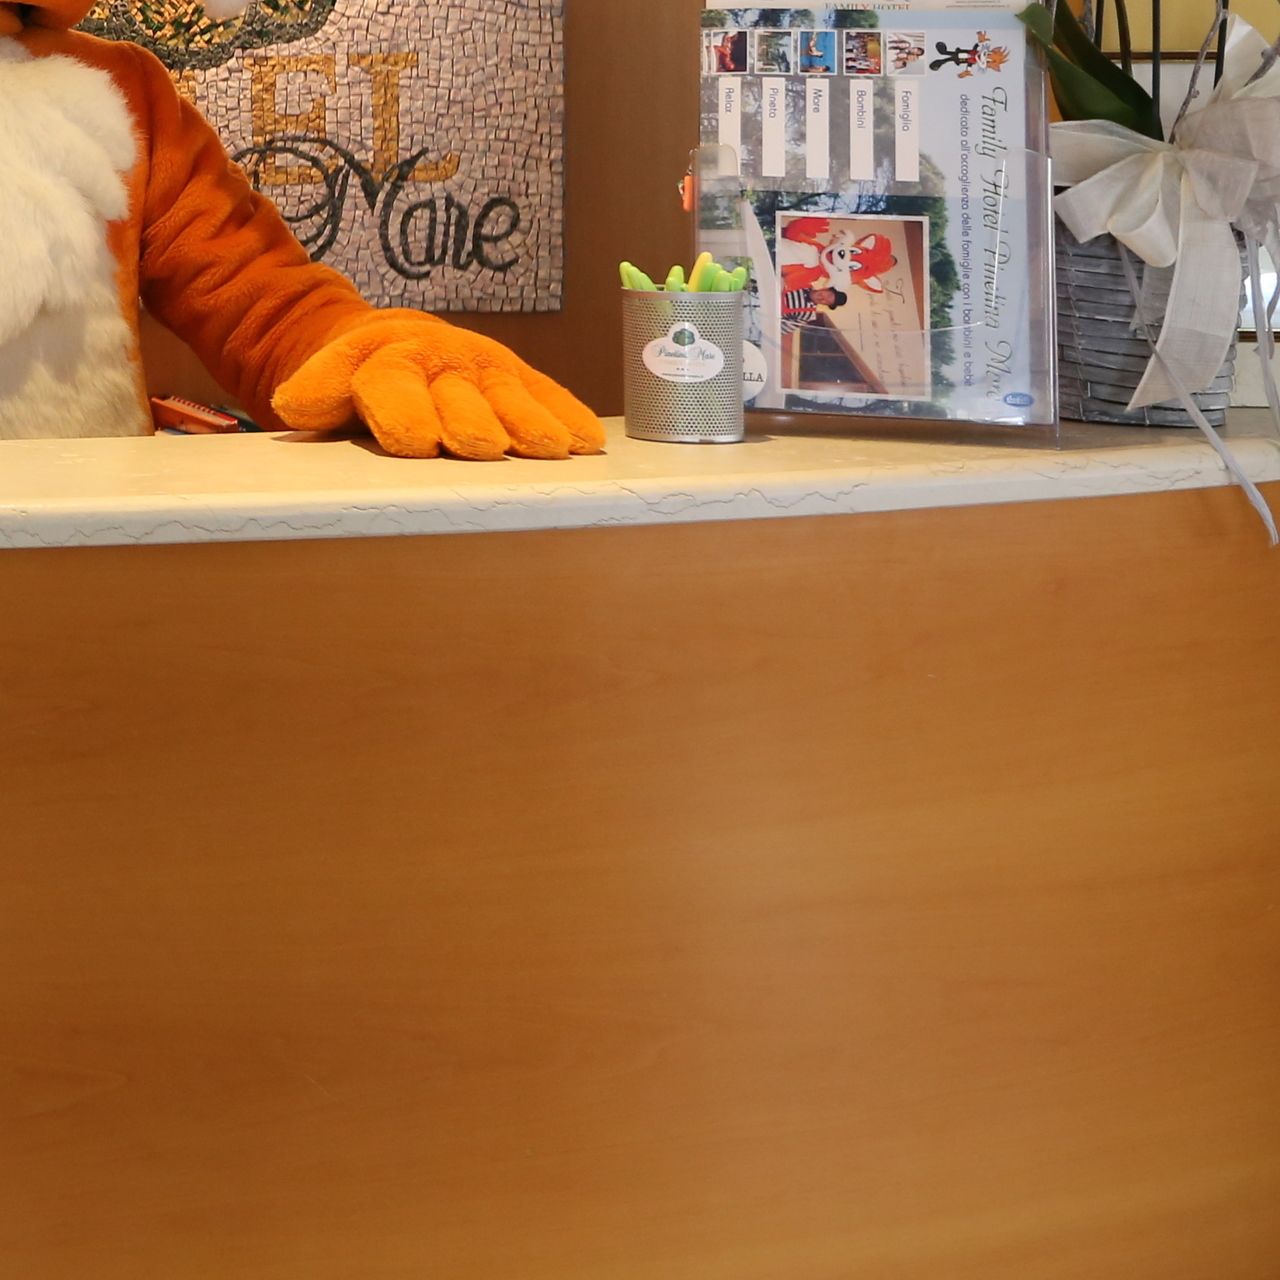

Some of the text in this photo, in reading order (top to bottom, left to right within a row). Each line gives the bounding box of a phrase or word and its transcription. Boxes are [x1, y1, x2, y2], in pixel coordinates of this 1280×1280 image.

[769, 87, 780, 119] Pineta
[813, 88, 823, 114] Mare
[856, 89, 867, 129] Bambini
[899, 90, 912, 132] Famiglia
[960, 94, 972, 138] dedicato
[975, 86, 1008, 160] Family
[980, 169, 1010, 234] Hotel
